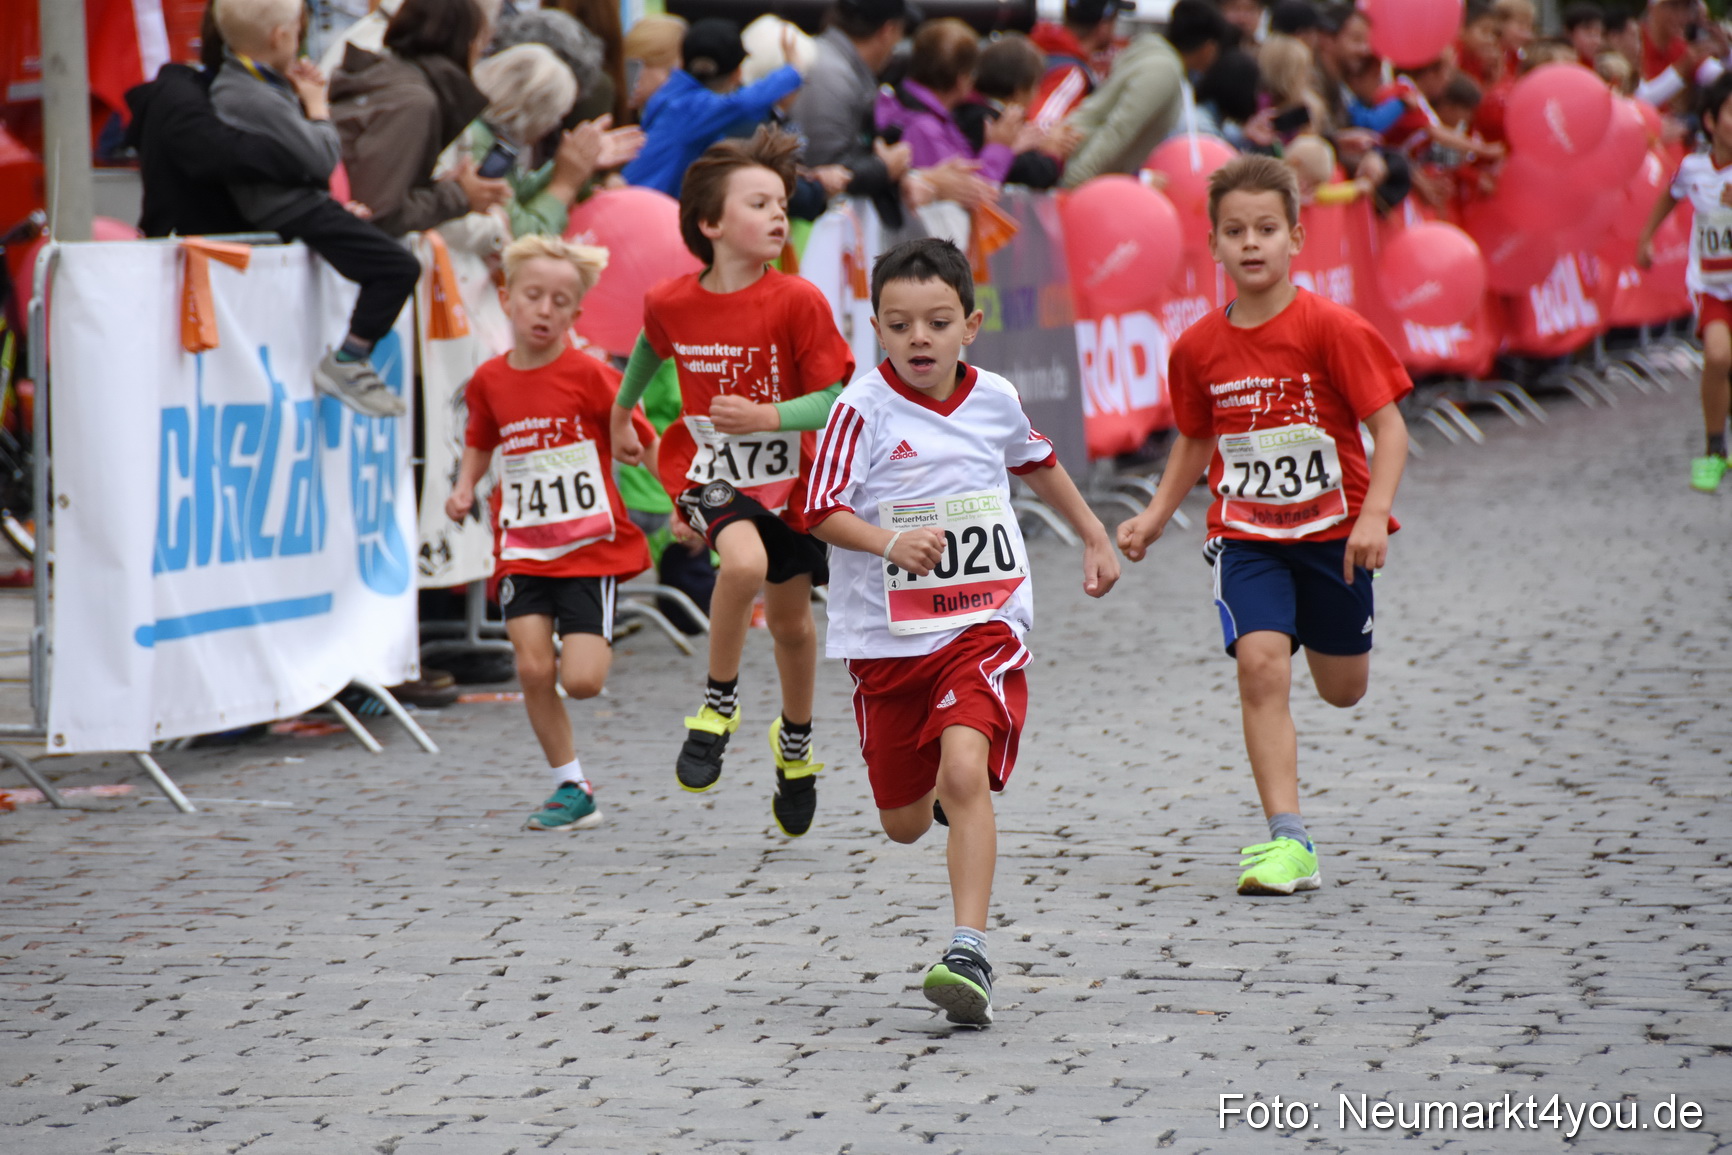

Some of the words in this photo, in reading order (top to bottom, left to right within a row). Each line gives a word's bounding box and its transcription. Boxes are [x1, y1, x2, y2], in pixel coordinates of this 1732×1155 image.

[1259, 427, 1321, 449] BOCK
[889, 451, 918, 461] adidas
[1233, 449, 1330, 498] 7234
[510, 470, 596, 520] 7416
[946, 495, 1002, 517] BOCK
[892, 513, 939, 524] NeuerMarkt
[1248, 504, 1320, 525] Johannes
[906, 522, 1016, 582] 020
[932, 591, 994, 614] Ruben
